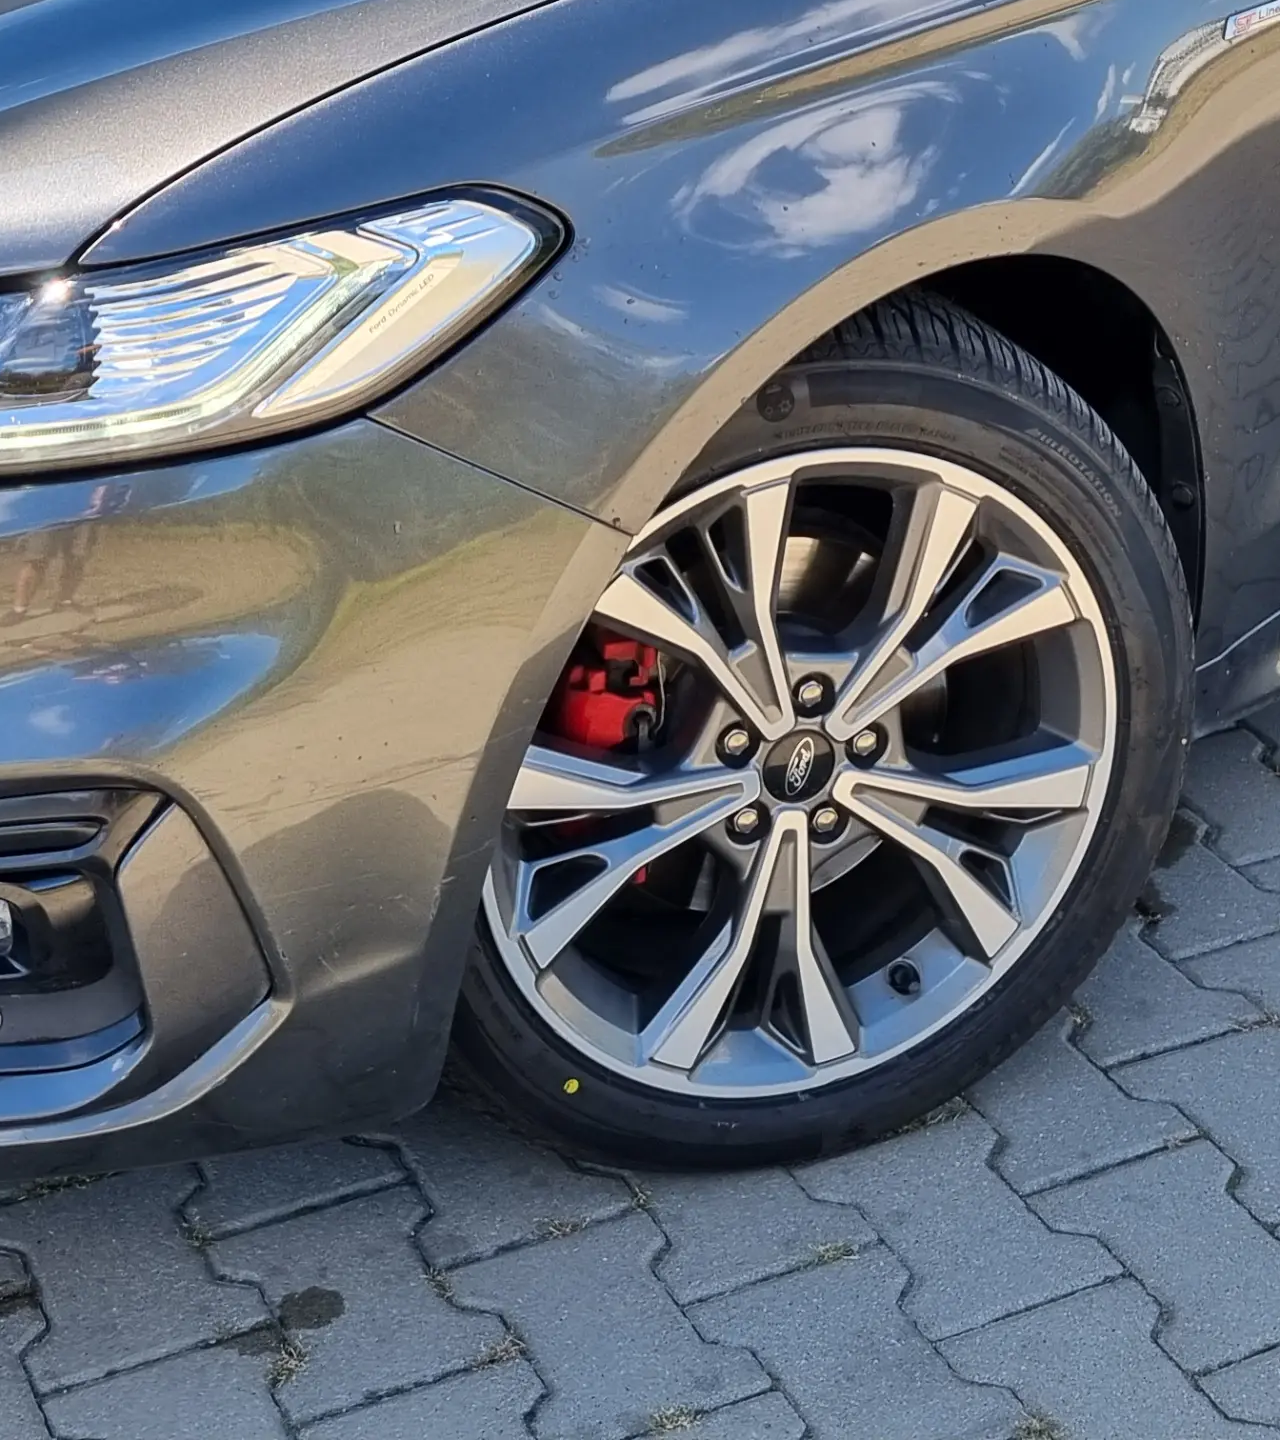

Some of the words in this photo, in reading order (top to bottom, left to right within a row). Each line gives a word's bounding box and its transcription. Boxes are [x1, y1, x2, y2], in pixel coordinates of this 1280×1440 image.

[1233, 12, 1256, 35] ST
[1259, 6, 1280, 19] Line
[369, 316, 387, 334] Ford
[388, 289, 419, 317] Dynamic
[419, 273, 435, 291] LED
[789, 748, 811, 787] Ford
